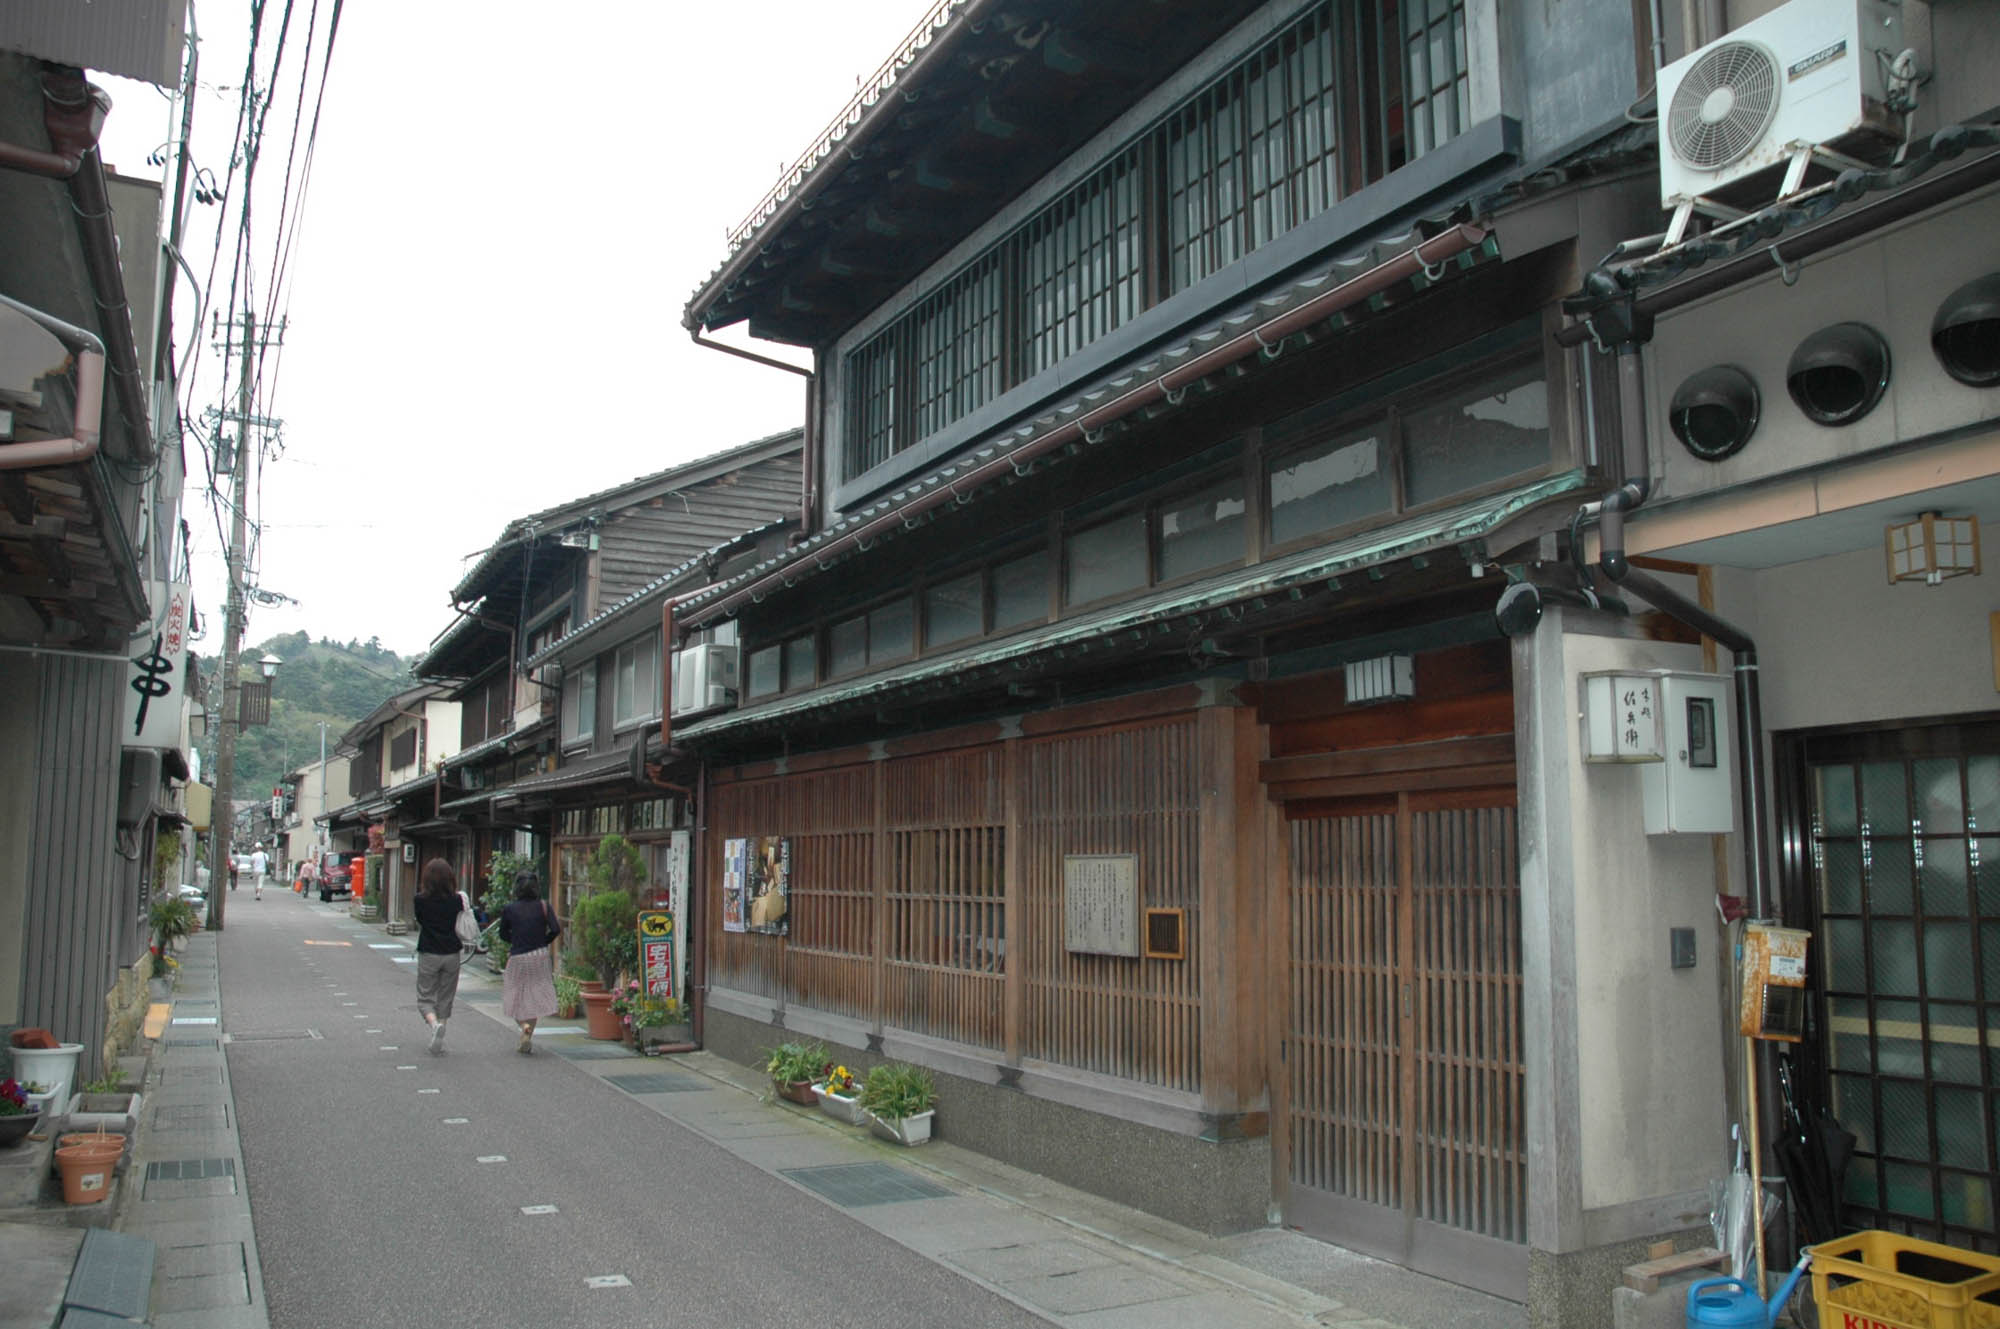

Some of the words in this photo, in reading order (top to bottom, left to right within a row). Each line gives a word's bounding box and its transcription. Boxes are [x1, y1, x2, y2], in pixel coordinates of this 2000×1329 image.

[1794, 46, 1840, 72] SHARP
[168, 604, 183, 645] 炭火焼
[131, 632, 173, 736] 串
[648, 945, 668, 997] 宅急便
